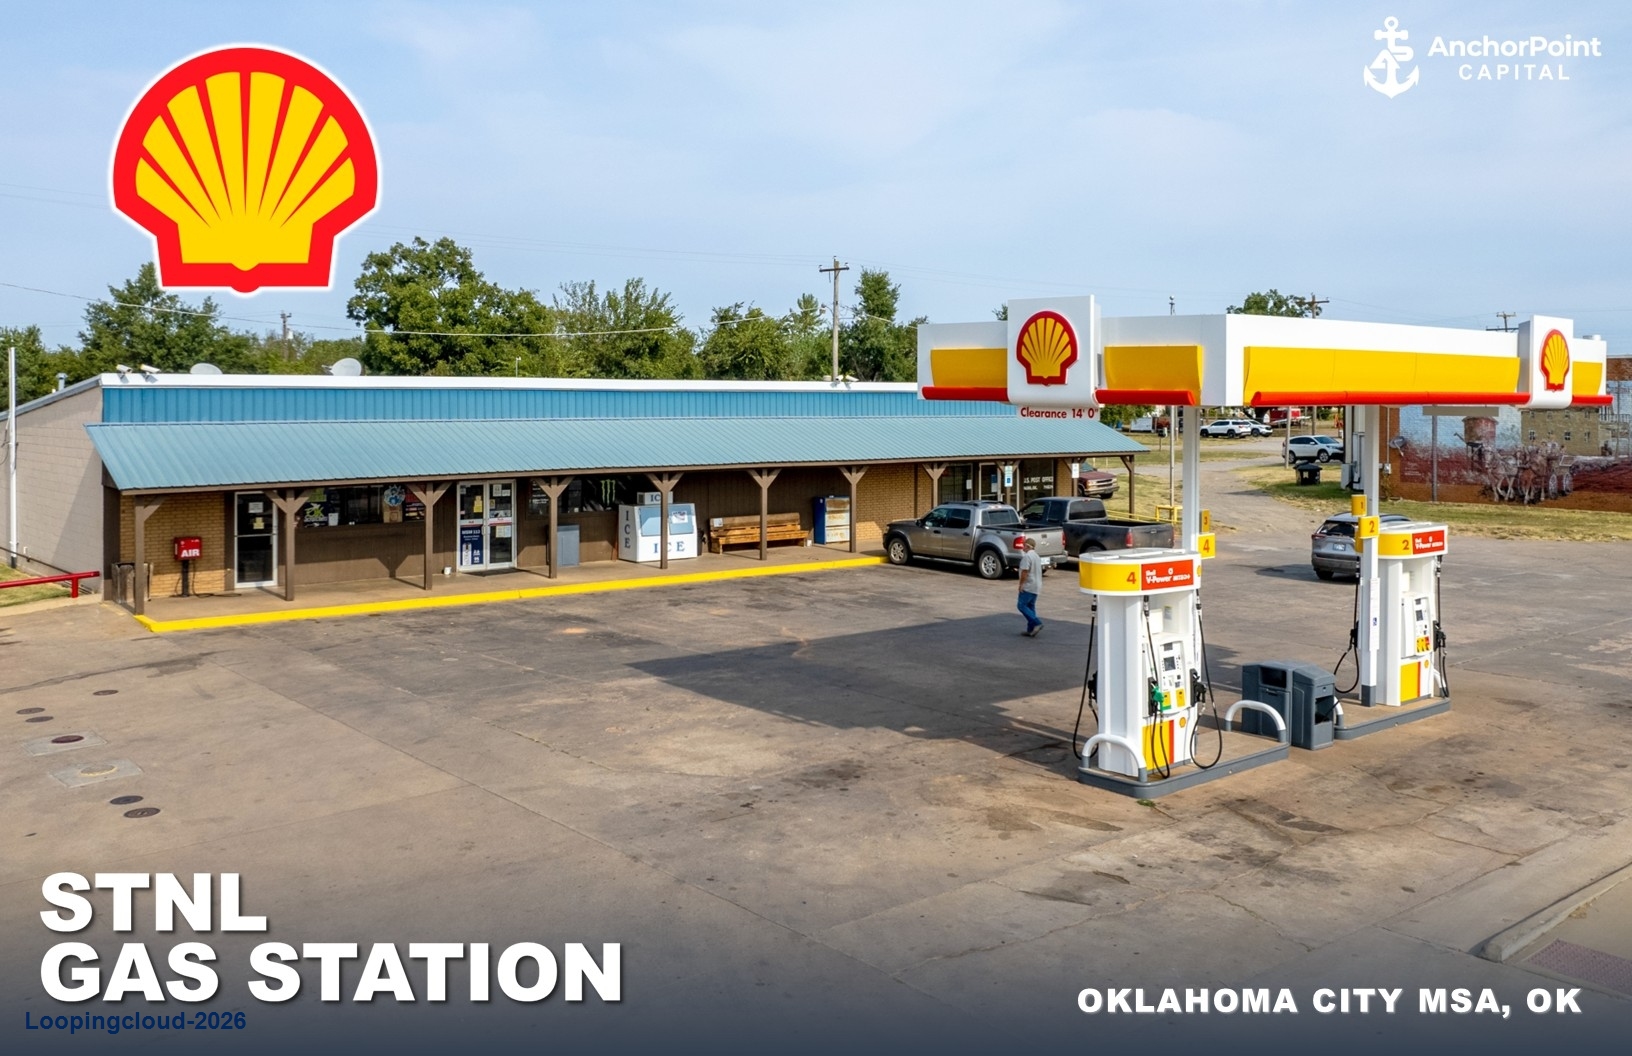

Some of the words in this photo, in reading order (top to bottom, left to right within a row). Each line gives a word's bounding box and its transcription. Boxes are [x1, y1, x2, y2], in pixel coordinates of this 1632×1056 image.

[1020, 407, 1067, 419] Clearance
[1072, 408, 1085, 419] 14'
[1369, 520, 1375, 533] 2
[1203, 539, 1210, 553] 4
[1402, 539, 1410, 550] 2
[181, 548, 200, 558] AIR
[1126, 572, 1136, 584] 4
